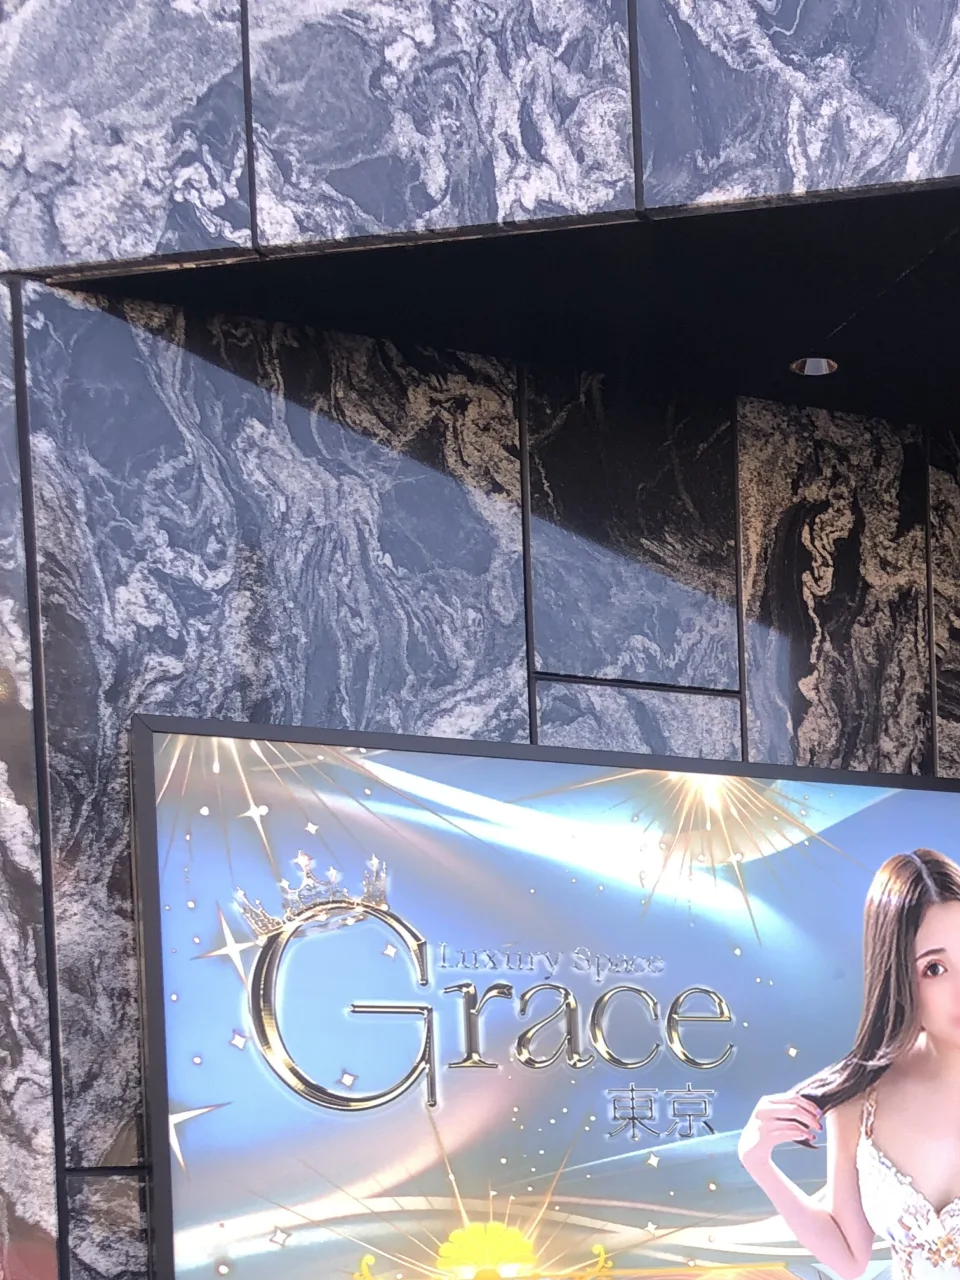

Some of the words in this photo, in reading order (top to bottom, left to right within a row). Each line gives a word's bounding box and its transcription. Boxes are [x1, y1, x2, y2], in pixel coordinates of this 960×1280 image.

[438, 941, 566, 979] Luxury
[571, 945, 667, 982] Space
[249, 899, 736, 1110] Grace
[607, 1082, 717, 1138] 東京
